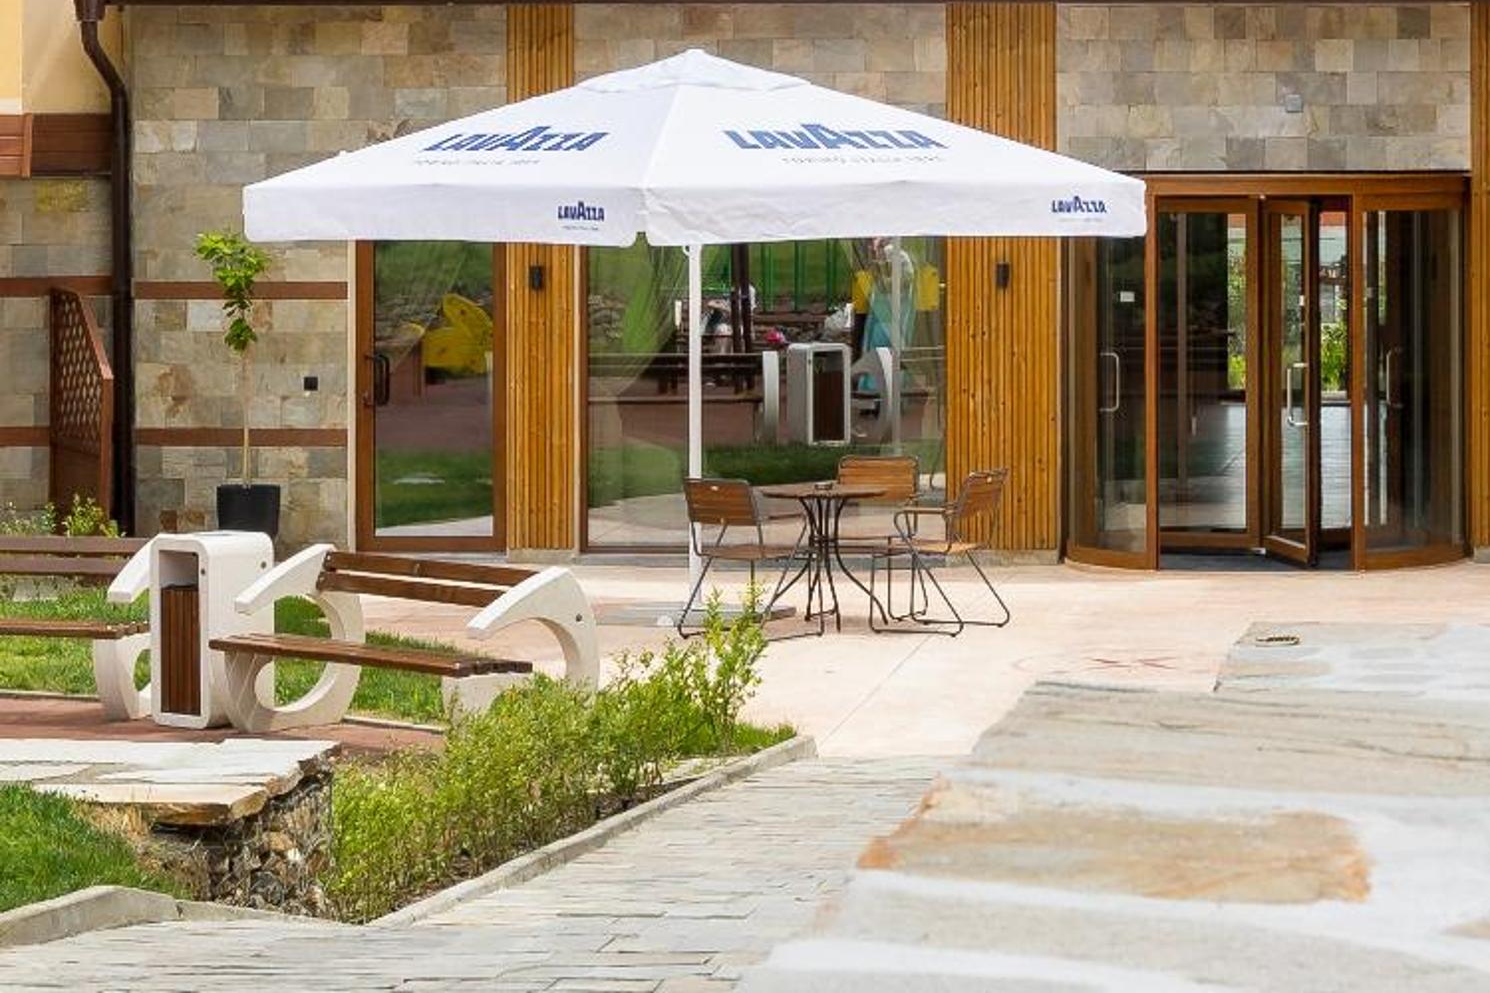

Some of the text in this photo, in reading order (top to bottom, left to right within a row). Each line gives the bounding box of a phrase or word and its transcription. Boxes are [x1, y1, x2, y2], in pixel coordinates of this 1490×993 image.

[421, 125, 610, 151] LAVAZZA
[723, 123, 949, 149] LAVAZZA
[558, 200, 605, 221] LAVAZZA
[1051, 195, 1107, 213] LAVAZZA
